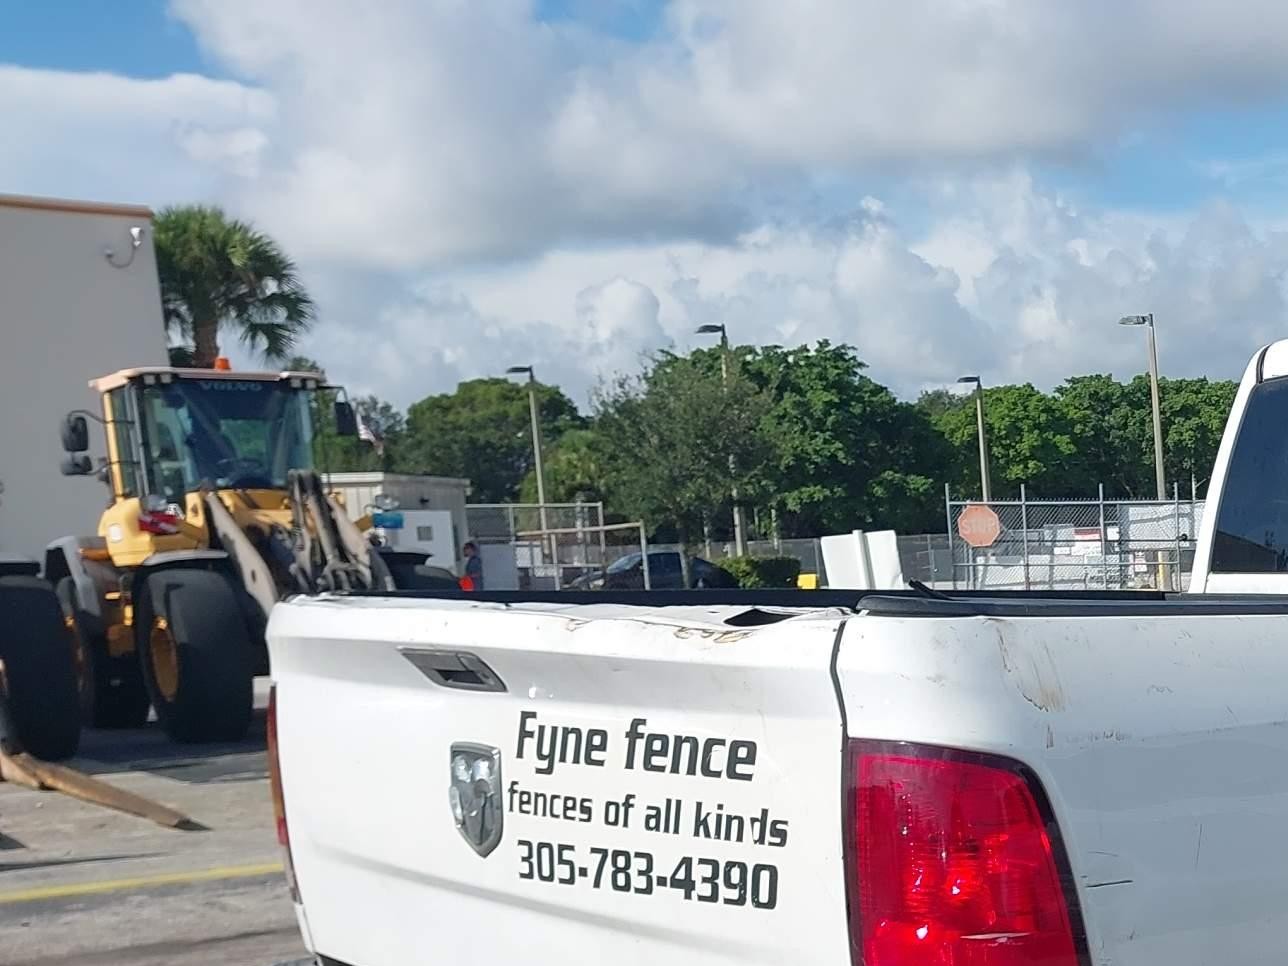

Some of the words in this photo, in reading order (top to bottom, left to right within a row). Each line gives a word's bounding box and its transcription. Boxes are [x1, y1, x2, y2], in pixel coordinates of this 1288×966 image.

[516, 710, 608, 775] Fyne
[624, 718, 758, 782] fence
[507, 780, 593, 823] fences
[604, 793, 636, 828] of
[644, 798, 682, 835] all
[693, 801, 789, 848] kinds
[517, 839, 779, 910] 305-783-4390
